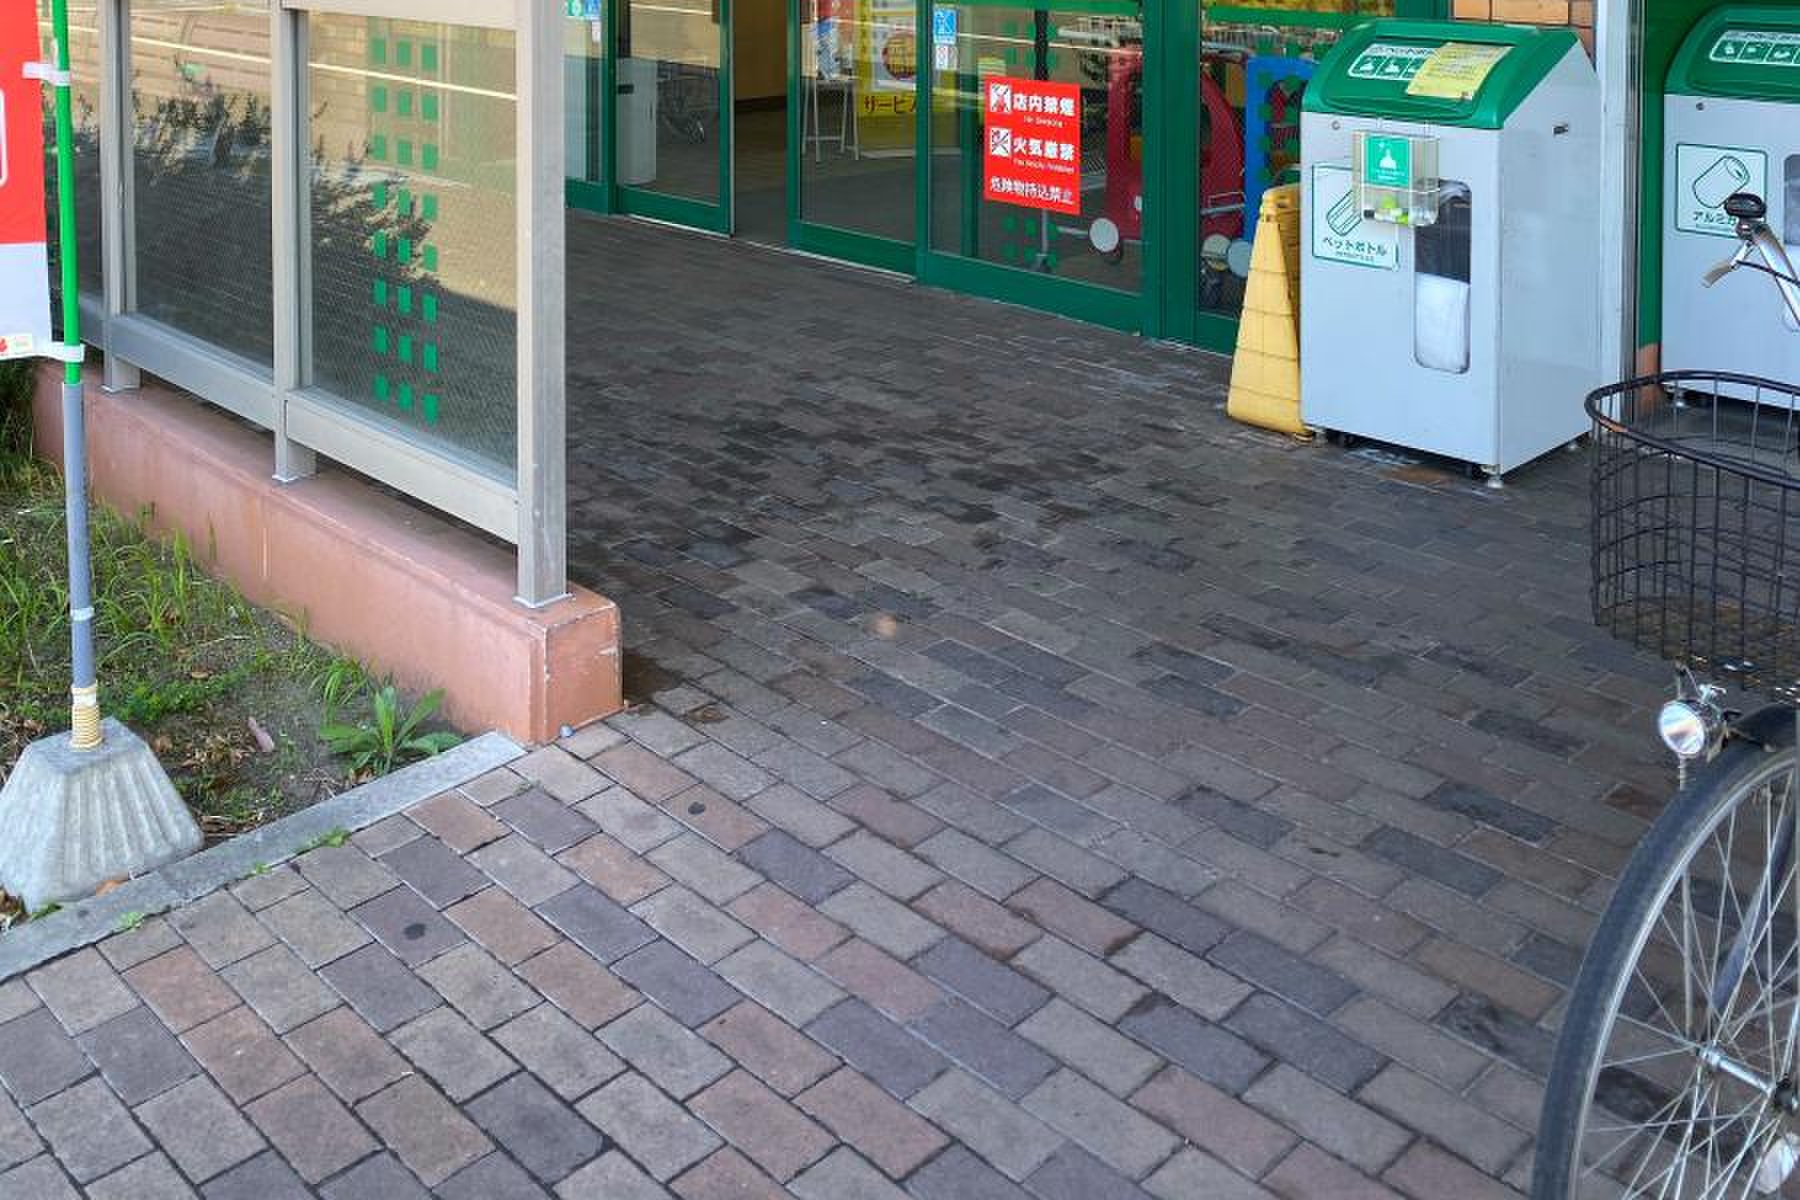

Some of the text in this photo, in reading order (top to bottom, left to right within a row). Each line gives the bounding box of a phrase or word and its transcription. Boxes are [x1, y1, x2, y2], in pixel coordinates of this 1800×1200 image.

[1013, 93, 1075, 117] 店内禁煙
[1013, 137, 1074, 161] 火気厳禁
[1323, 237, 1387, 257] ペットボトル
